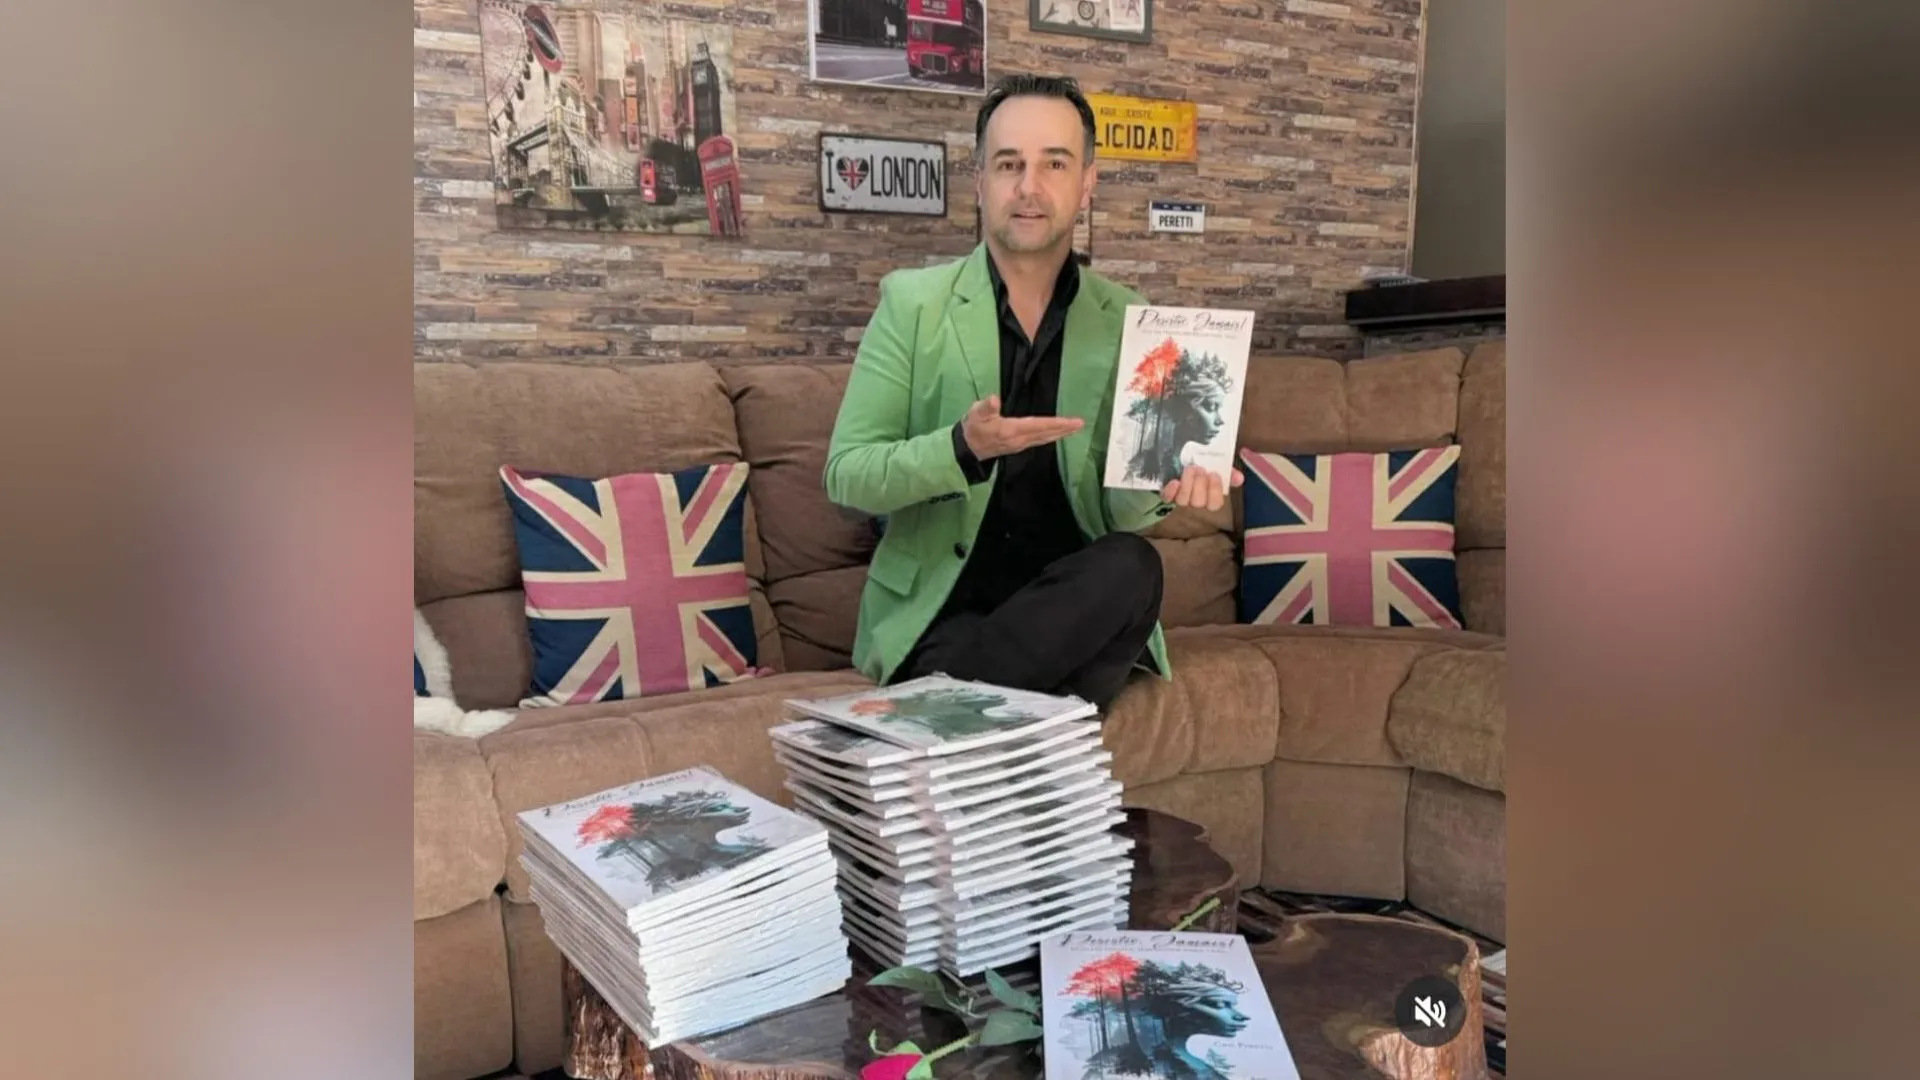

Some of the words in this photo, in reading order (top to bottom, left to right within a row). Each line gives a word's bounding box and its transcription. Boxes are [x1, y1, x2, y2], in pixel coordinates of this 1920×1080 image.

[825, 149, 835, 194] I
[870, 154, 941, 200] LONDON
[1159, 214, 1194, 228] PERETTI
